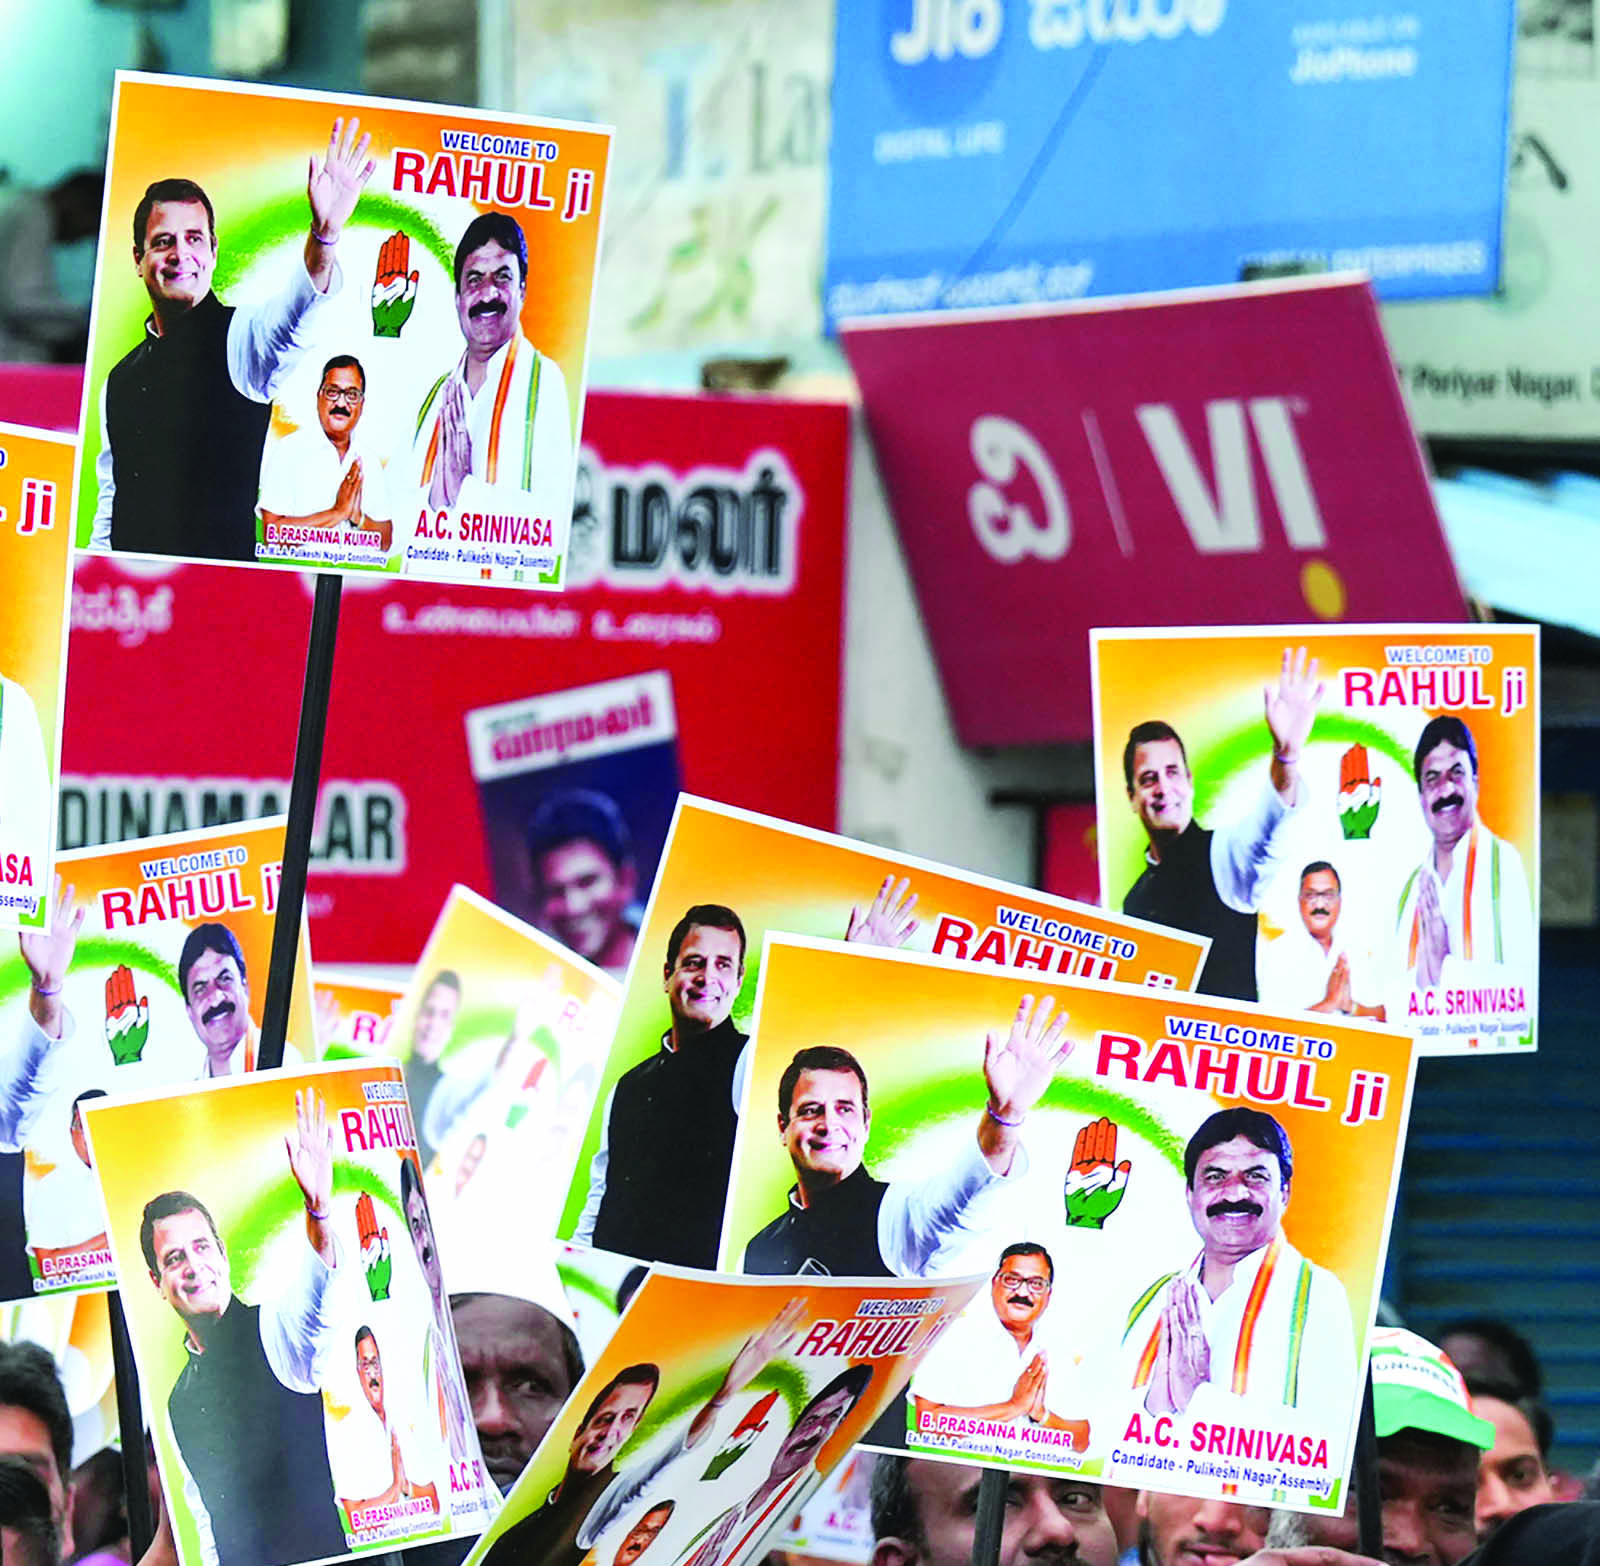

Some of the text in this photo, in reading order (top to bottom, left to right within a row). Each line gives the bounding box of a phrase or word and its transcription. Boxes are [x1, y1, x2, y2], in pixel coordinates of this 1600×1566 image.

[443, 132, 557, 159] WELCOME TO
[393, 151, 592, 220] RAHUL ji
[21, 480, 55, 532] ji
[280, 527, 340, 544] PRASANNA
[343, 532, 380, 547] KUMAR
[415, 510, 552, 547] A.C. SRINIVASA
[407, 545, 493, 566] Candidate Pulikeshi
[1388, 648, 1491, 663] WELCOME TO
[1344, 670, 1523, 713] RAHUL ji
[61, 789, 394, 863] DINAMAAR
[143, 848, 246, 879] WELCOME TO
[102, 873, 251, 930] RAHUL
[1000, 908, 1135, 960] WELCOME TO
[1408, 987, 1526, 1016] A.C. SRINIVASA
[1169, 1017, 1333, 1059] WELCOME TO
[1096, 1034, 1385, 1122] RAHUL ji
[856, 1299, 922, 1316] WELCOME
[795, 1320, 919, 1358] RAHUL
[922, 1414, 1071, 1447] B. PRASANNA KUMAR
[1124, 1413, 1328, 1469] A.C. SRINIVASA
[923, 1436, 1082, 1467] M.L.A. Pulikeshi Nagar Constituency
[1112, 1450, 1331, 1495] Candidate Pulikeshi Nagar Assembly
